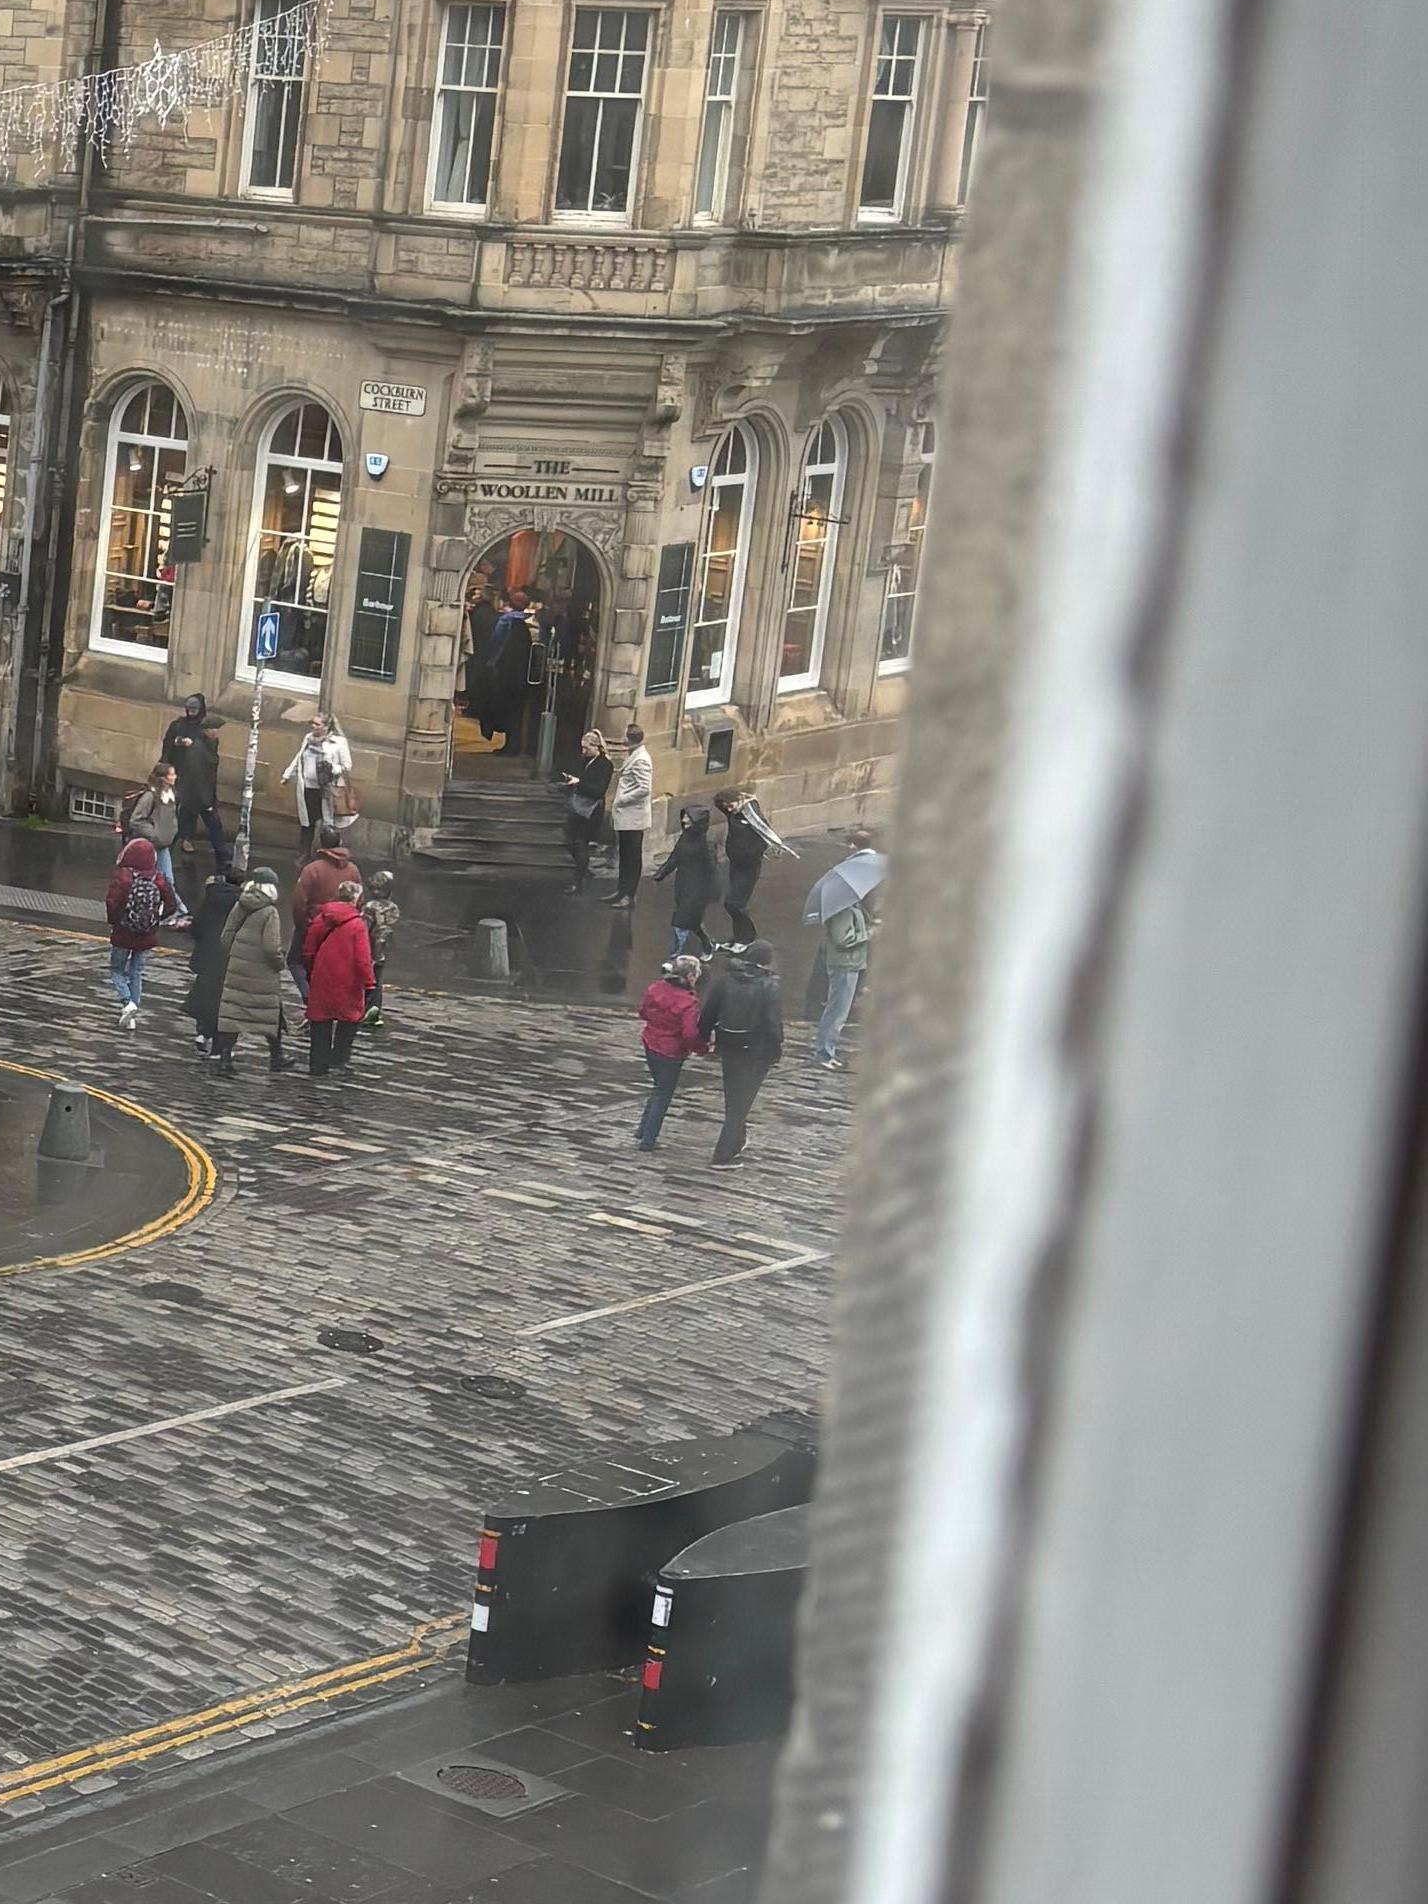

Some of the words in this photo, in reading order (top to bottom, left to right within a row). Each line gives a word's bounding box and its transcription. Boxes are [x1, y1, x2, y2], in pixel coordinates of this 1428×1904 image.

[364, 383, 423, 401] COCKBURN
[373, 397, 411, 411] STREET
[534, 460, 571, 475] THE
[480, 484, 569, 501] WOOLLEN
[574, 487, 618, 503] MILL
